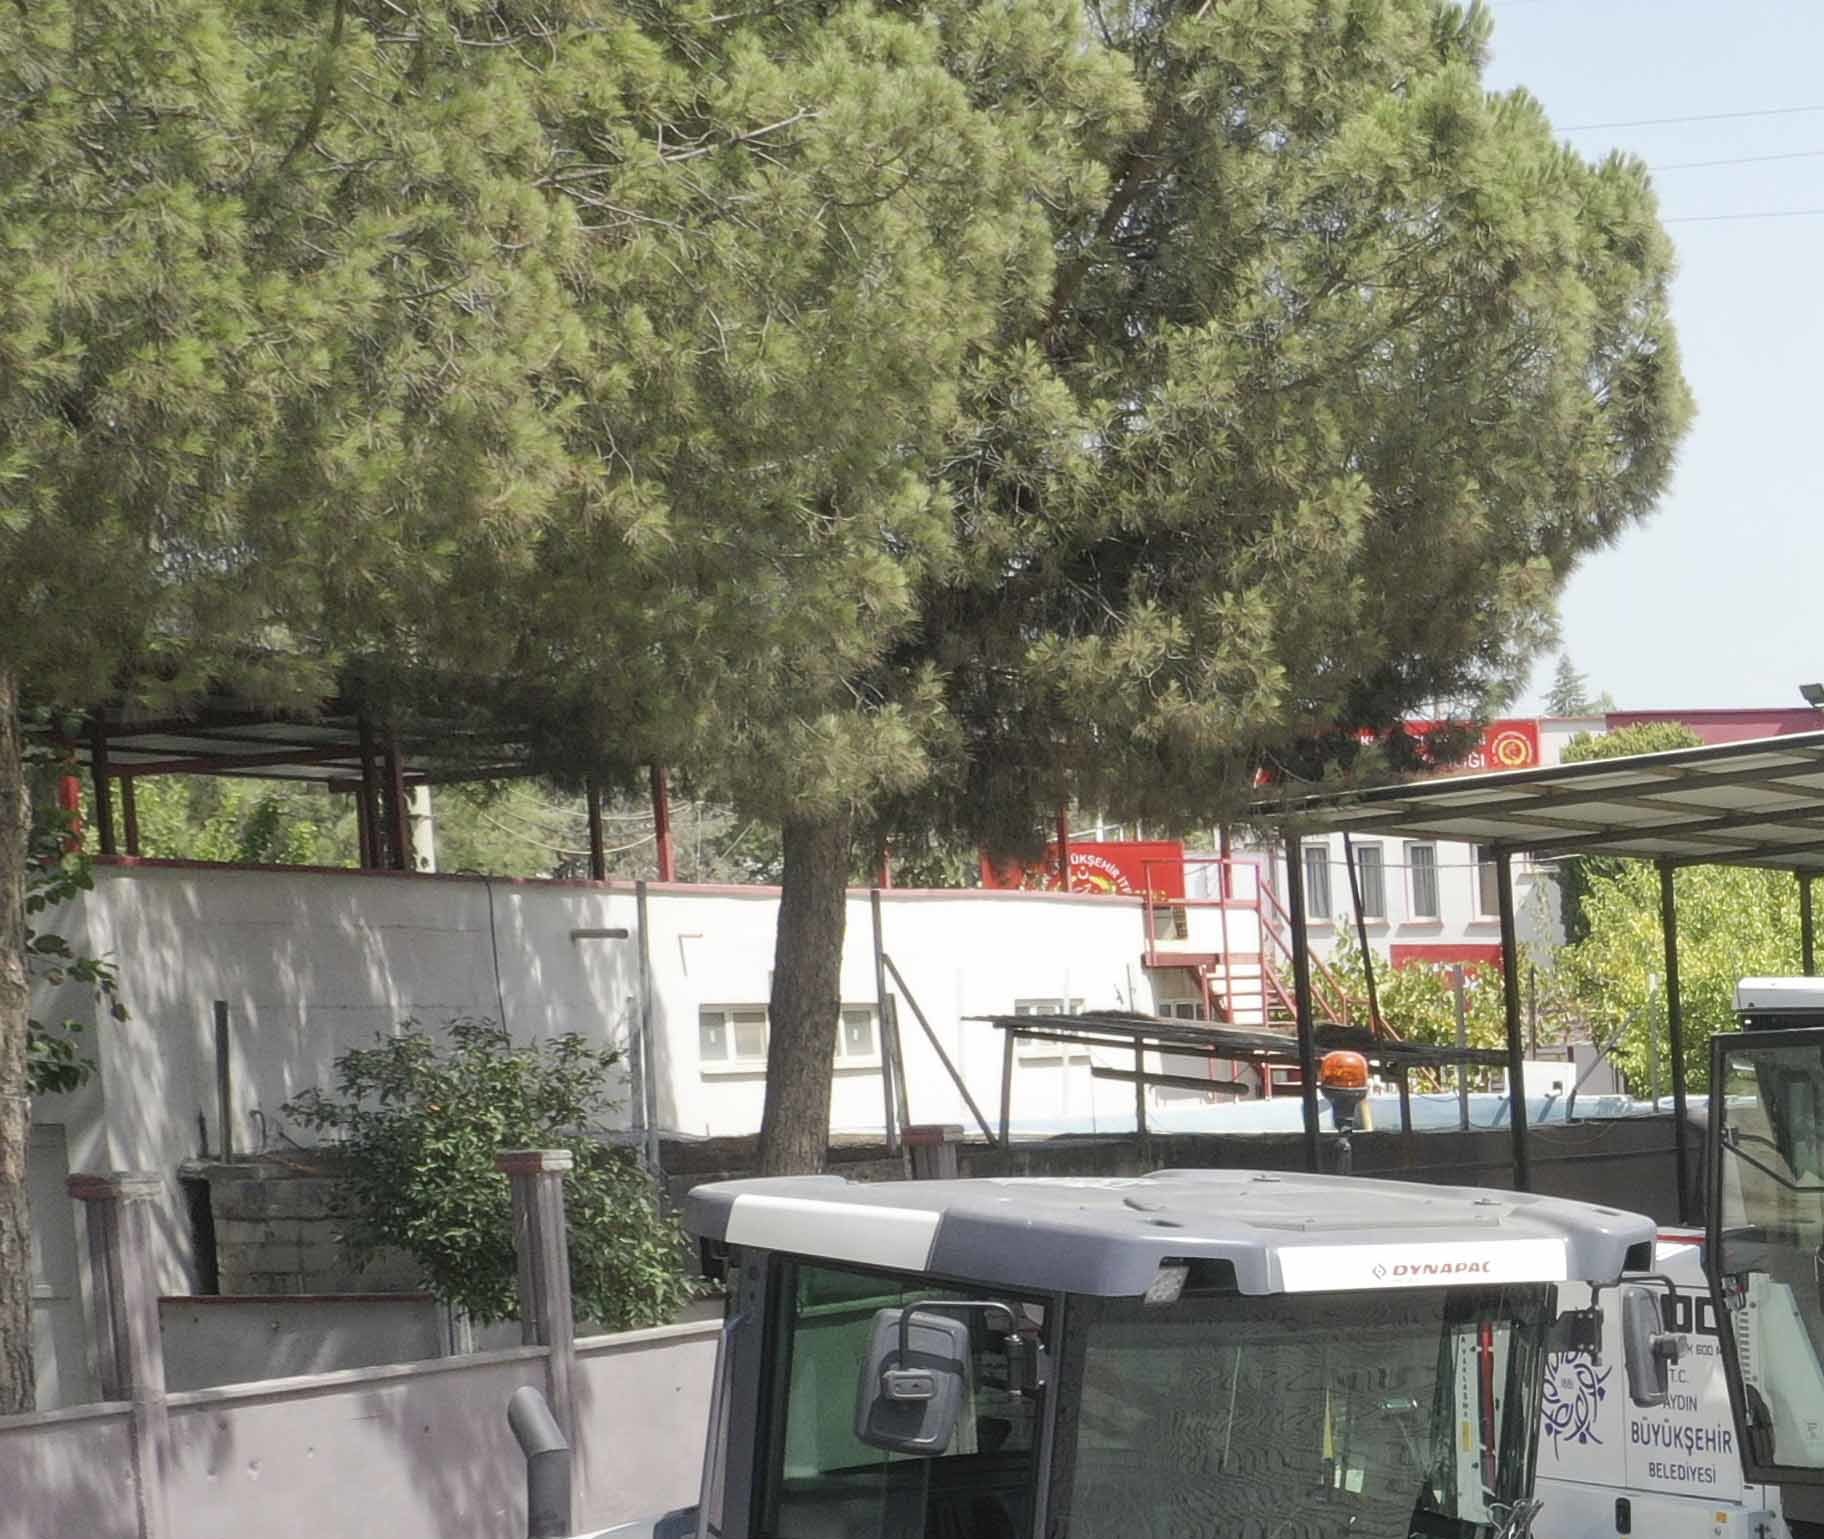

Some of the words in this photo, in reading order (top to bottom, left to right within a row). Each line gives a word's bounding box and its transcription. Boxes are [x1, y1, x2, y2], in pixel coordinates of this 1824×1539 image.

[1392, 1261, 1491, 1276] DYNAPAC
[1670, 1368, 1688, 1384] T.C.
[1663, 1395, 1698, 1412] AYDIN
[1631, 1416, 1733, 1456] BÜYÜKŞEHİR
[1648, 1462, 1717, 1485] BELEDİYESİ
